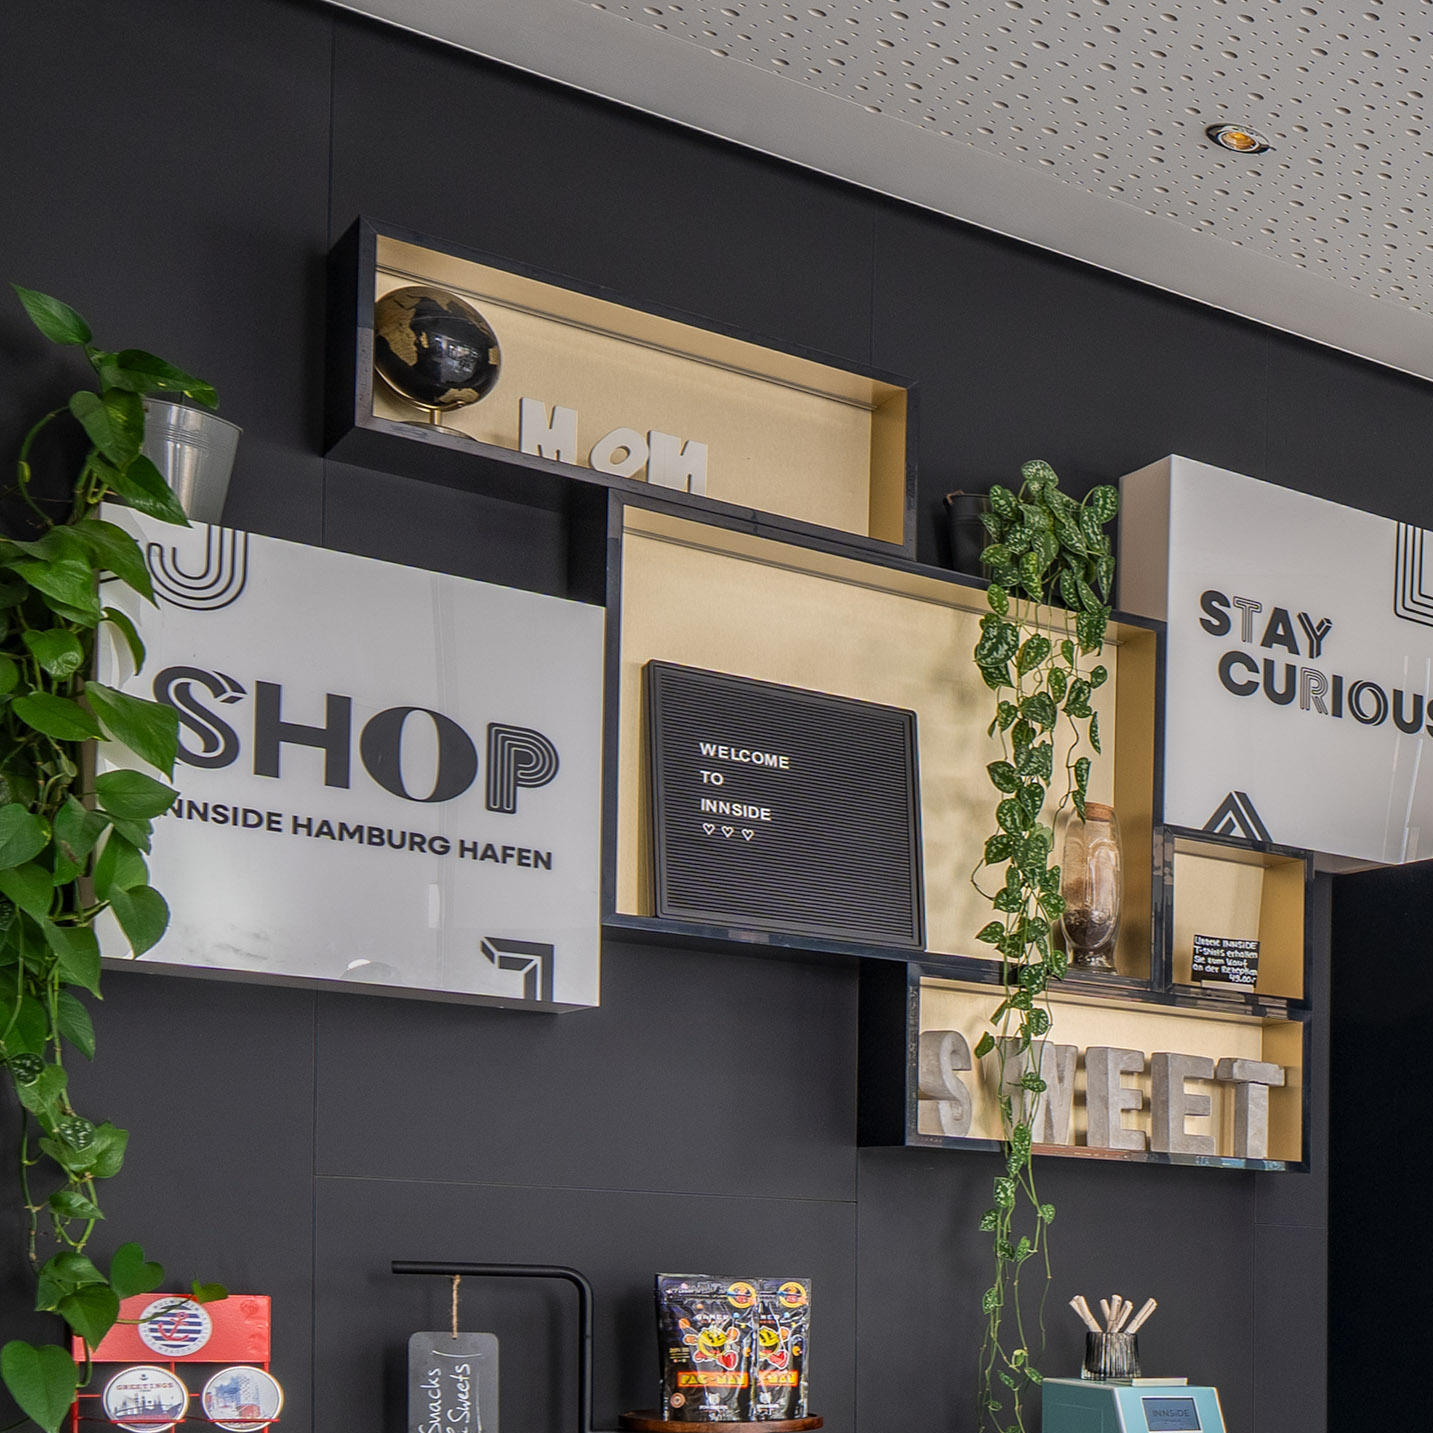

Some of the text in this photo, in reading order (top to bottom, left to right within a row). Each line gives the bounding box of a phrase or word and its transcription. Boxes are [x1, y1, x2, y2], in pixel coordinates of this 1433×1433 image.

[1199, 589, 1332, 660] STAY
[152, 665, 560, 815] SHOP
[699, 742, 790, 770] WELCOME
[700, 769, 724, 787] TO
[163, 797, 553, 872] NNSIDE HAMBURG HAFEN
[700, 797, 772, 822] INNSIDE
[918, 1029, 1287, 1160] SWEET
[449, 1362, 471, 1424] Sweets
[679, 1373, 747, 1385] PAC-MAN
